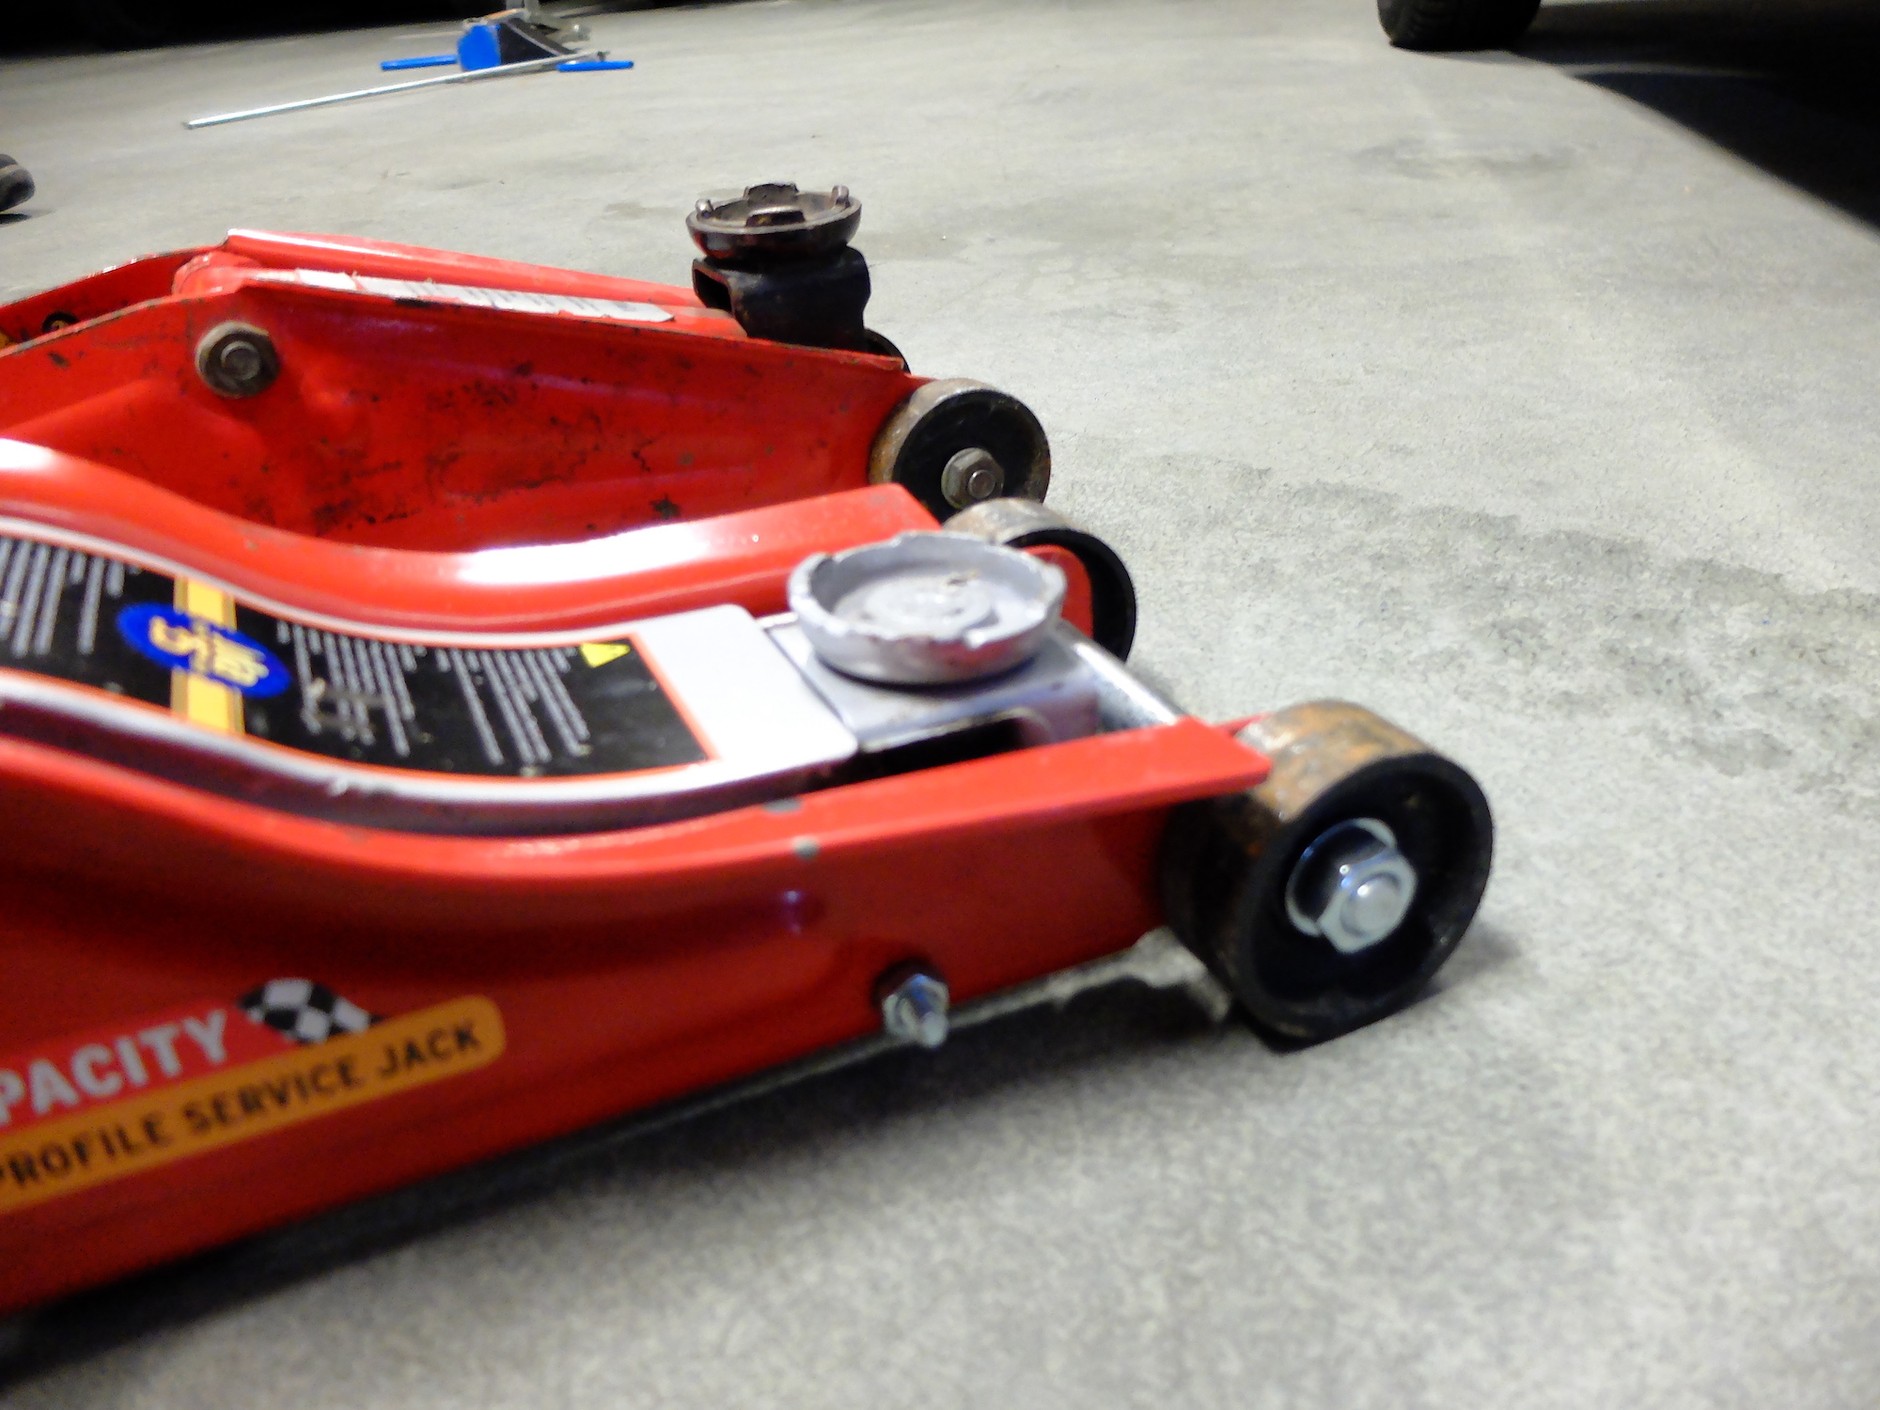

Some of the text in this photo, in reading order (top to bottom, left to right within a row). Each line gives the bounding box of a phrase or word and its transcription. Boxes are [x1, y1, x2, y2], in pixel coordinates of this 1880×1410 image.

[0, 1020, 482, 1188] ROFILE SERVICE JACK
